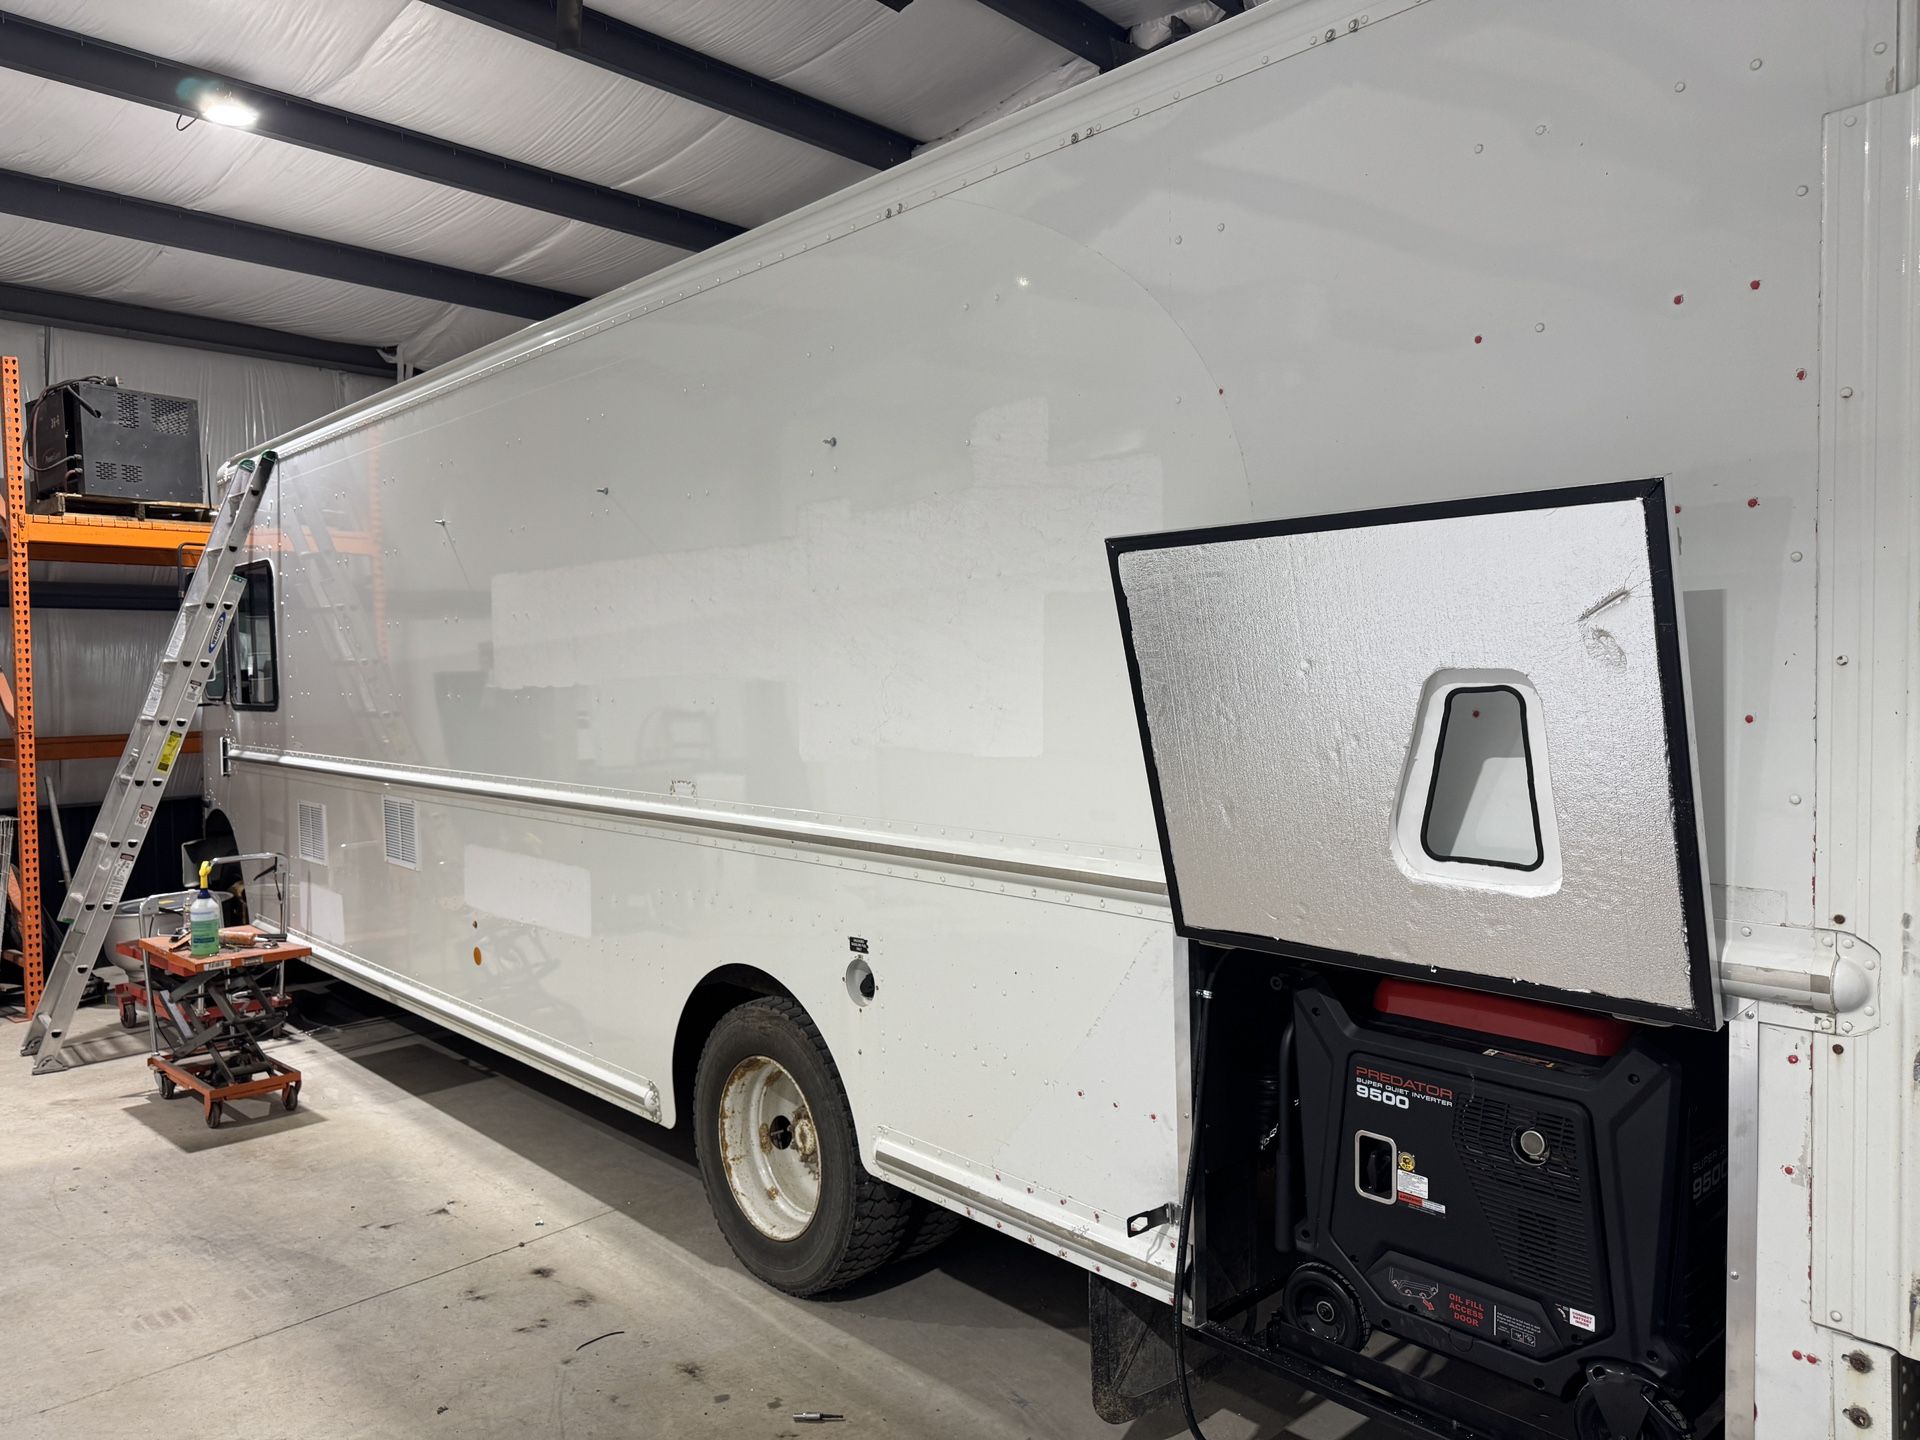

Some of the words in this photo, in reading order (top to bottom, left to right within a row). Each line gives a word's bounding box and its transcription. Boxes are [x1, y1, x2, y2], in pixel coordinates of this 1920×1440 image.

[211, 620, 224, 645] WERNER
[1356, 1066, 1453, 1100] PREDATOR
[1356, 1077, 1383, 1089] SUPER
[1385, 1085, 1409, 1096] QUIET
[1411, 1092, 1453, 1108] INVERTER
[1356, 1084, 1410, 1110] 9500
[1448, 1293, 1464, 1304] OIL
[1465, 1299, 1485, 1312] FILL
[1449, 1302, 1484, 1320] ACCESS
[1454, 1312, 1479, 1327] DOOR
